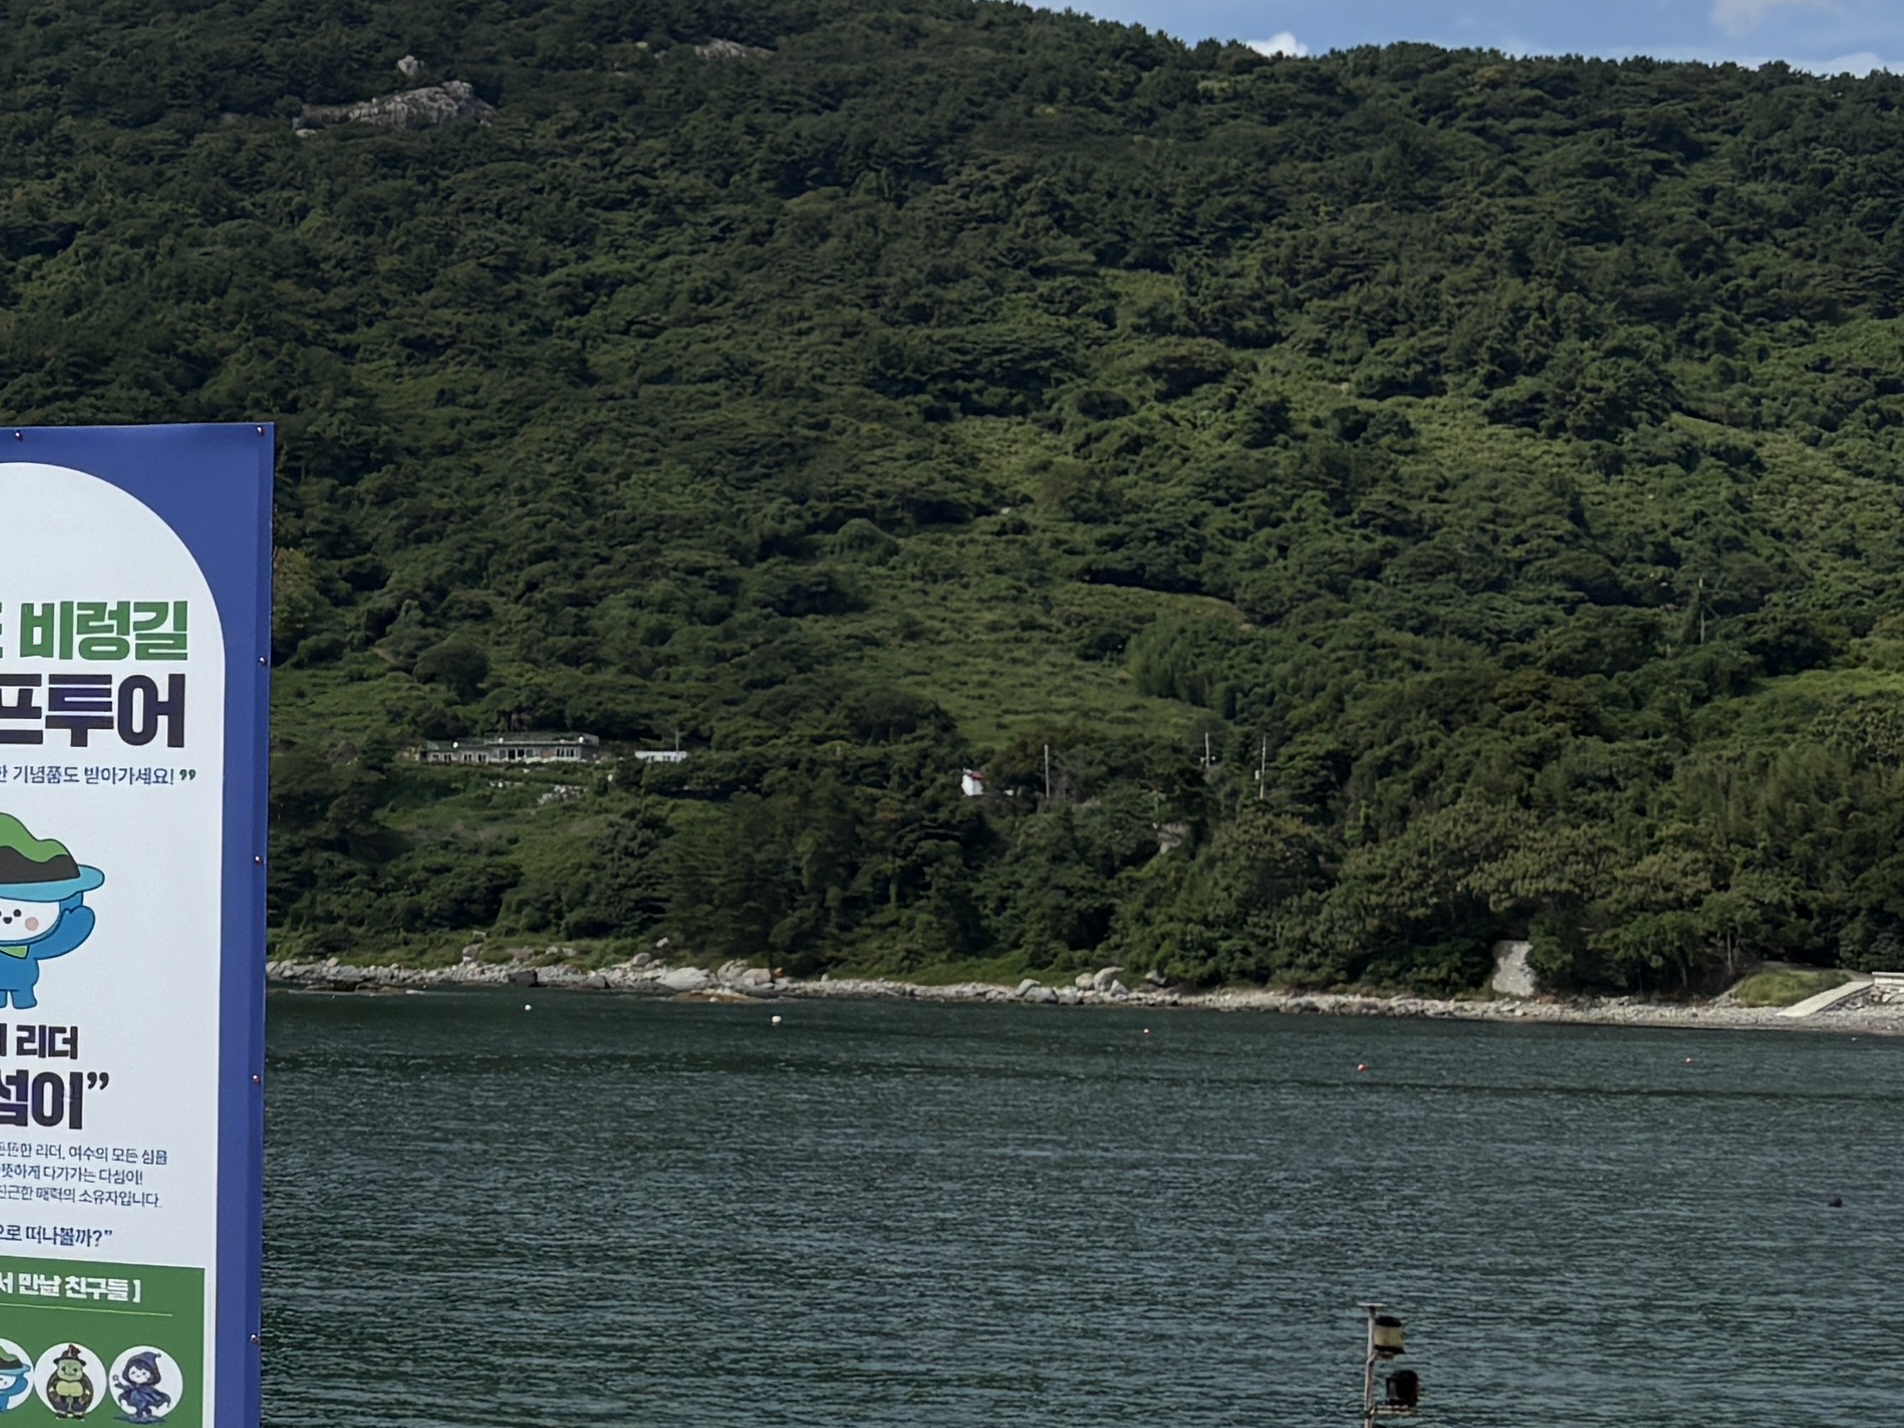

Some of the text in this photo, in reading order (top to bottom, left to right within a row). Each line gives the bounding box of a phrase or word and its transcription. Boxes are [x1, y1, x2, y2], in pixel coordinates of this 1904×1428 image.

[20, 601, 188, 660] 비렁길
[13, 765, 80, 784] 기념품도
[84, 766, 174, 785] 받아가세요!
[16, 1024, 78, 1060] 리더
[112, 1148, 138, 1164] 모든
[44, 1166, 96, 1183] 다가가는
[19, 1273, 62, 1297] 만날
[65, 1276, 129, 1302] 친구들
